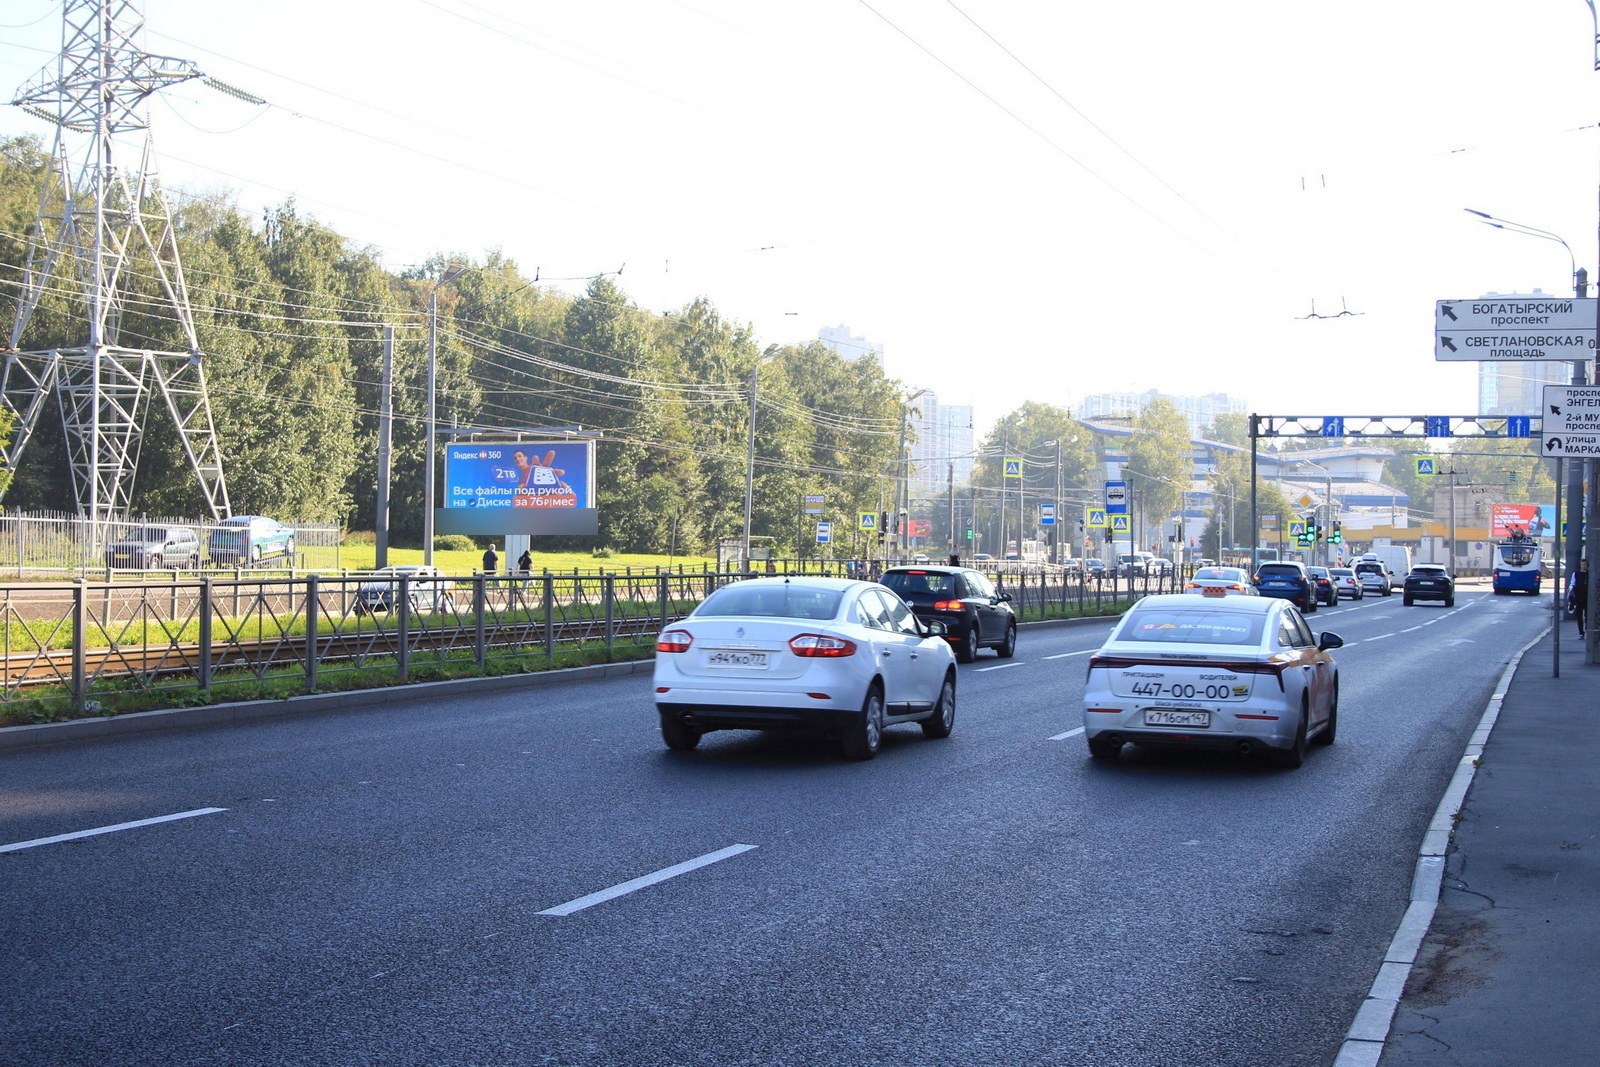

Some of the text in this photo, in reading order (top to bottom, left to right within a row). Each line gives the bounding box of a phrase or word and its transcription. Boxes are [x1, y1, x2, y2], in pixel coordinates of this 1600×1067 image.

[1472, 300, 1573, 314] БОГАТЫРСКИЙ
[1491, 315, 1549, 326] проспект
[1465, 336, 1584, 347] СВЕТЛАНОВСКАЯ
[1490, 349, 1546, 358] площадь
[1566, 413, 1582, 421] 2-й
[488, 451, 502, 459] 360
[453, 485, 573, 496] Все файлы под рукой
[477, 498, 512, 508] Диске
[1131, 682, 1230, 699] 447-00-00
